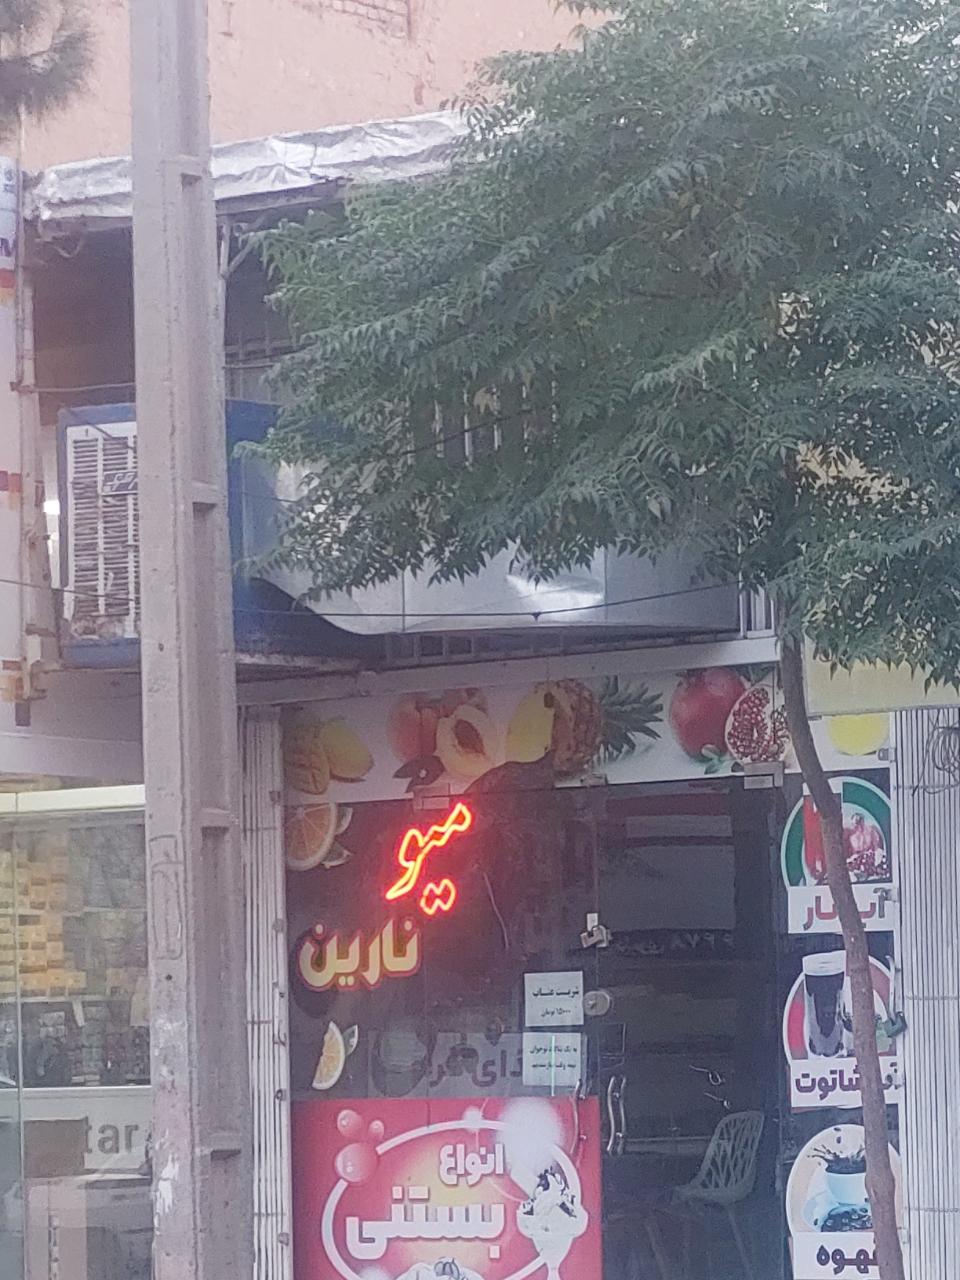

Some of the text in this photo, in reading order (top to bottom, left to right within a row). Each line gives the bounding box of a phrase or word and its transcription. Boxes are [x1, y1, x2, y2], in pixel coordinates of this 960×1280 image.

[803, 894, 840, 931] نار
[299, 916, 421, 990] نارین
[439, 1143, 504, 1186] انواع
[345, 1185, 506, 1260] بستنی
[816, 1244, 878, 1276] هوه
